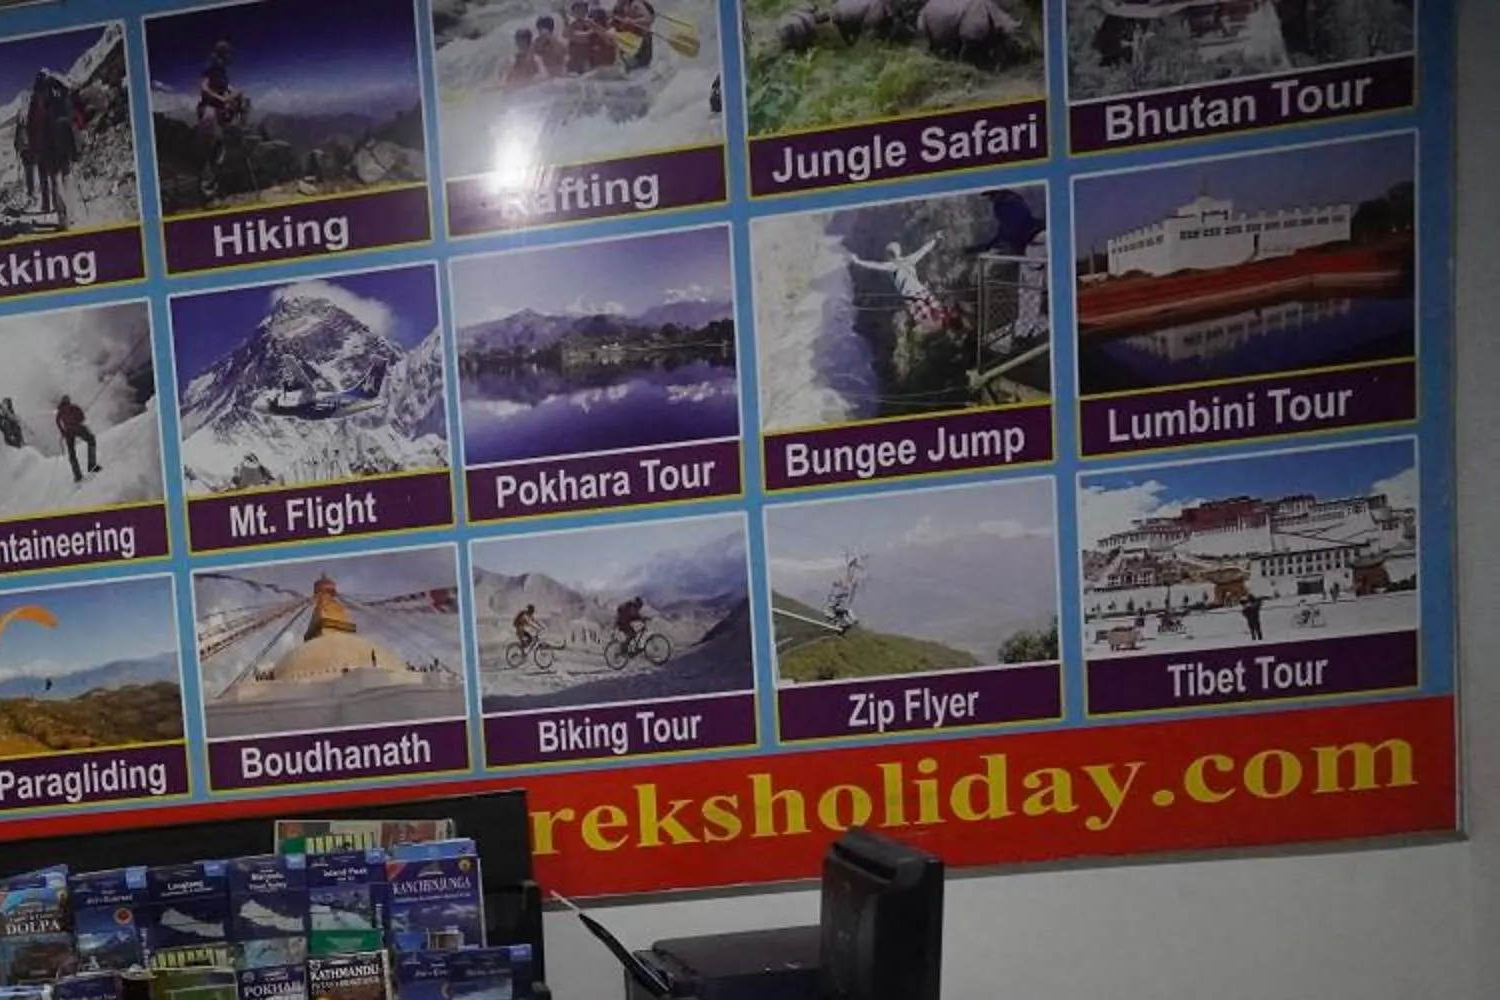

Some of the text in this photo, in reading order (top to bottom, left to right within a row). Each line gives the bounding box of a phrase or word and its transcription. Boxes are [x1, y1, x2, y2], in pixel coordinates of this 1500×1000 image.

[1105, 73, 1372, 143] Bhutan Tour
[772, 113, 1038, 187] Jungle Safari
[213, 212, 350, 259] Hiking
[1107, 382, 1352, 444] Lumbini Tour
[785, 418, 1026, 487] Bungee Jump
[495, 457, 715, 509] Pokhara Tour
[230, 491, 378, 538] Mt. Flight
[1167, 653, 1328, 697] Tibet Tour
[538, 708, 702, 757] Biking Tour
[848, 685, 980, 733] Zip Flyer
[240, 734, 432, 781] Boudhanath
[4, 919, 61, 936] DOLPA
[310, 964, 380, 982] KATHMANDU
